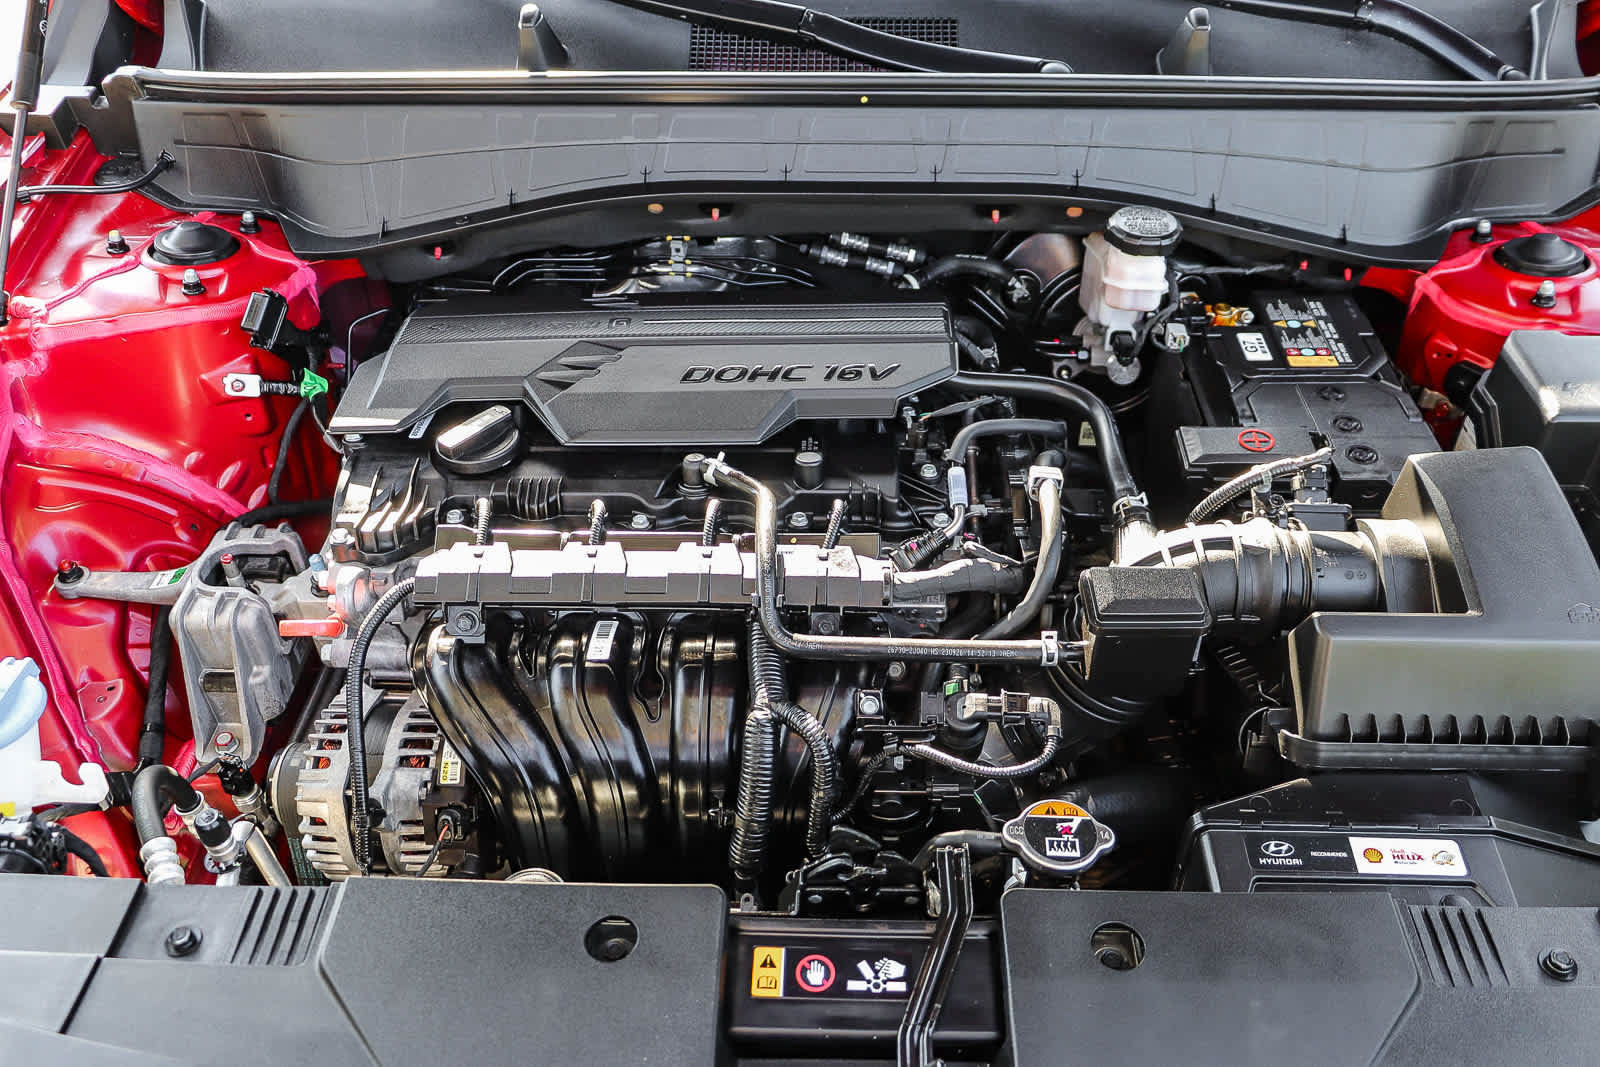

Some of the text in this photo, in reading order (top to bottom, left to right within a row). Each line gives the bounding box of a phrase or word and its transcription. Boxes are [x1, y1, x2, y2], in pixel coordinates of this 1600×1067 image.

[679, 363, 902, 384] DOHC 16V
[1259, 857, 1303, 866] HYUNDAI
[1391, 853, 1425, 861] HELIX
